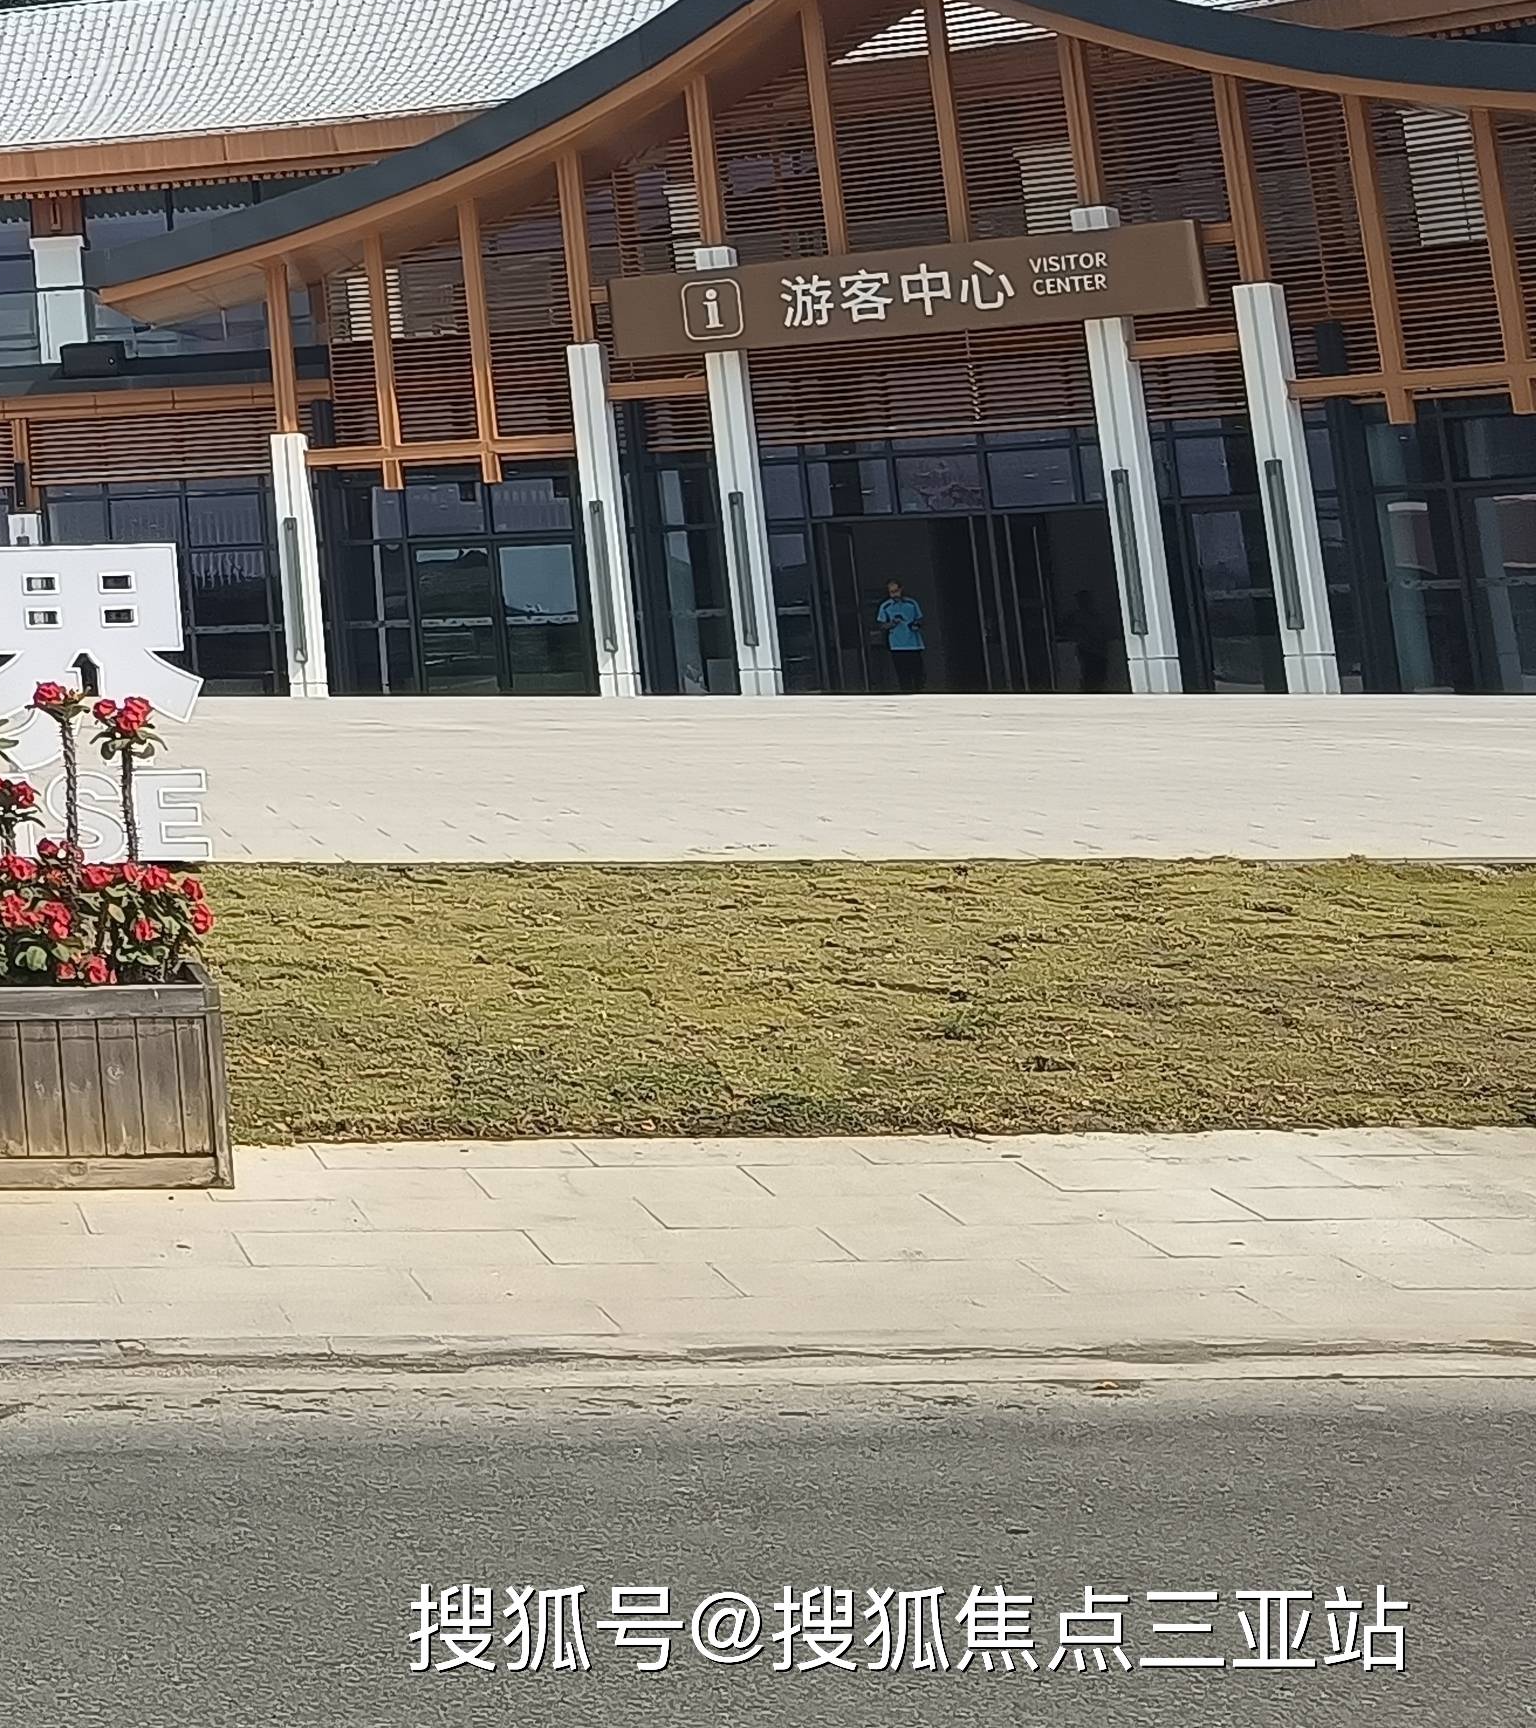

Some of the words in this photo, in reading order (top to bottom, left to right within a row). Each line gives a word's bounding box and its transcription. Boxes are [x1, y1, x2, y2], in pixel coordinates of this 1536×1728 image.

[1028, 251, 1108, 274] VISITOR
[779, 259, 1015, 328] 游客中心
[1032, 273, 1108, 296] CENTER
